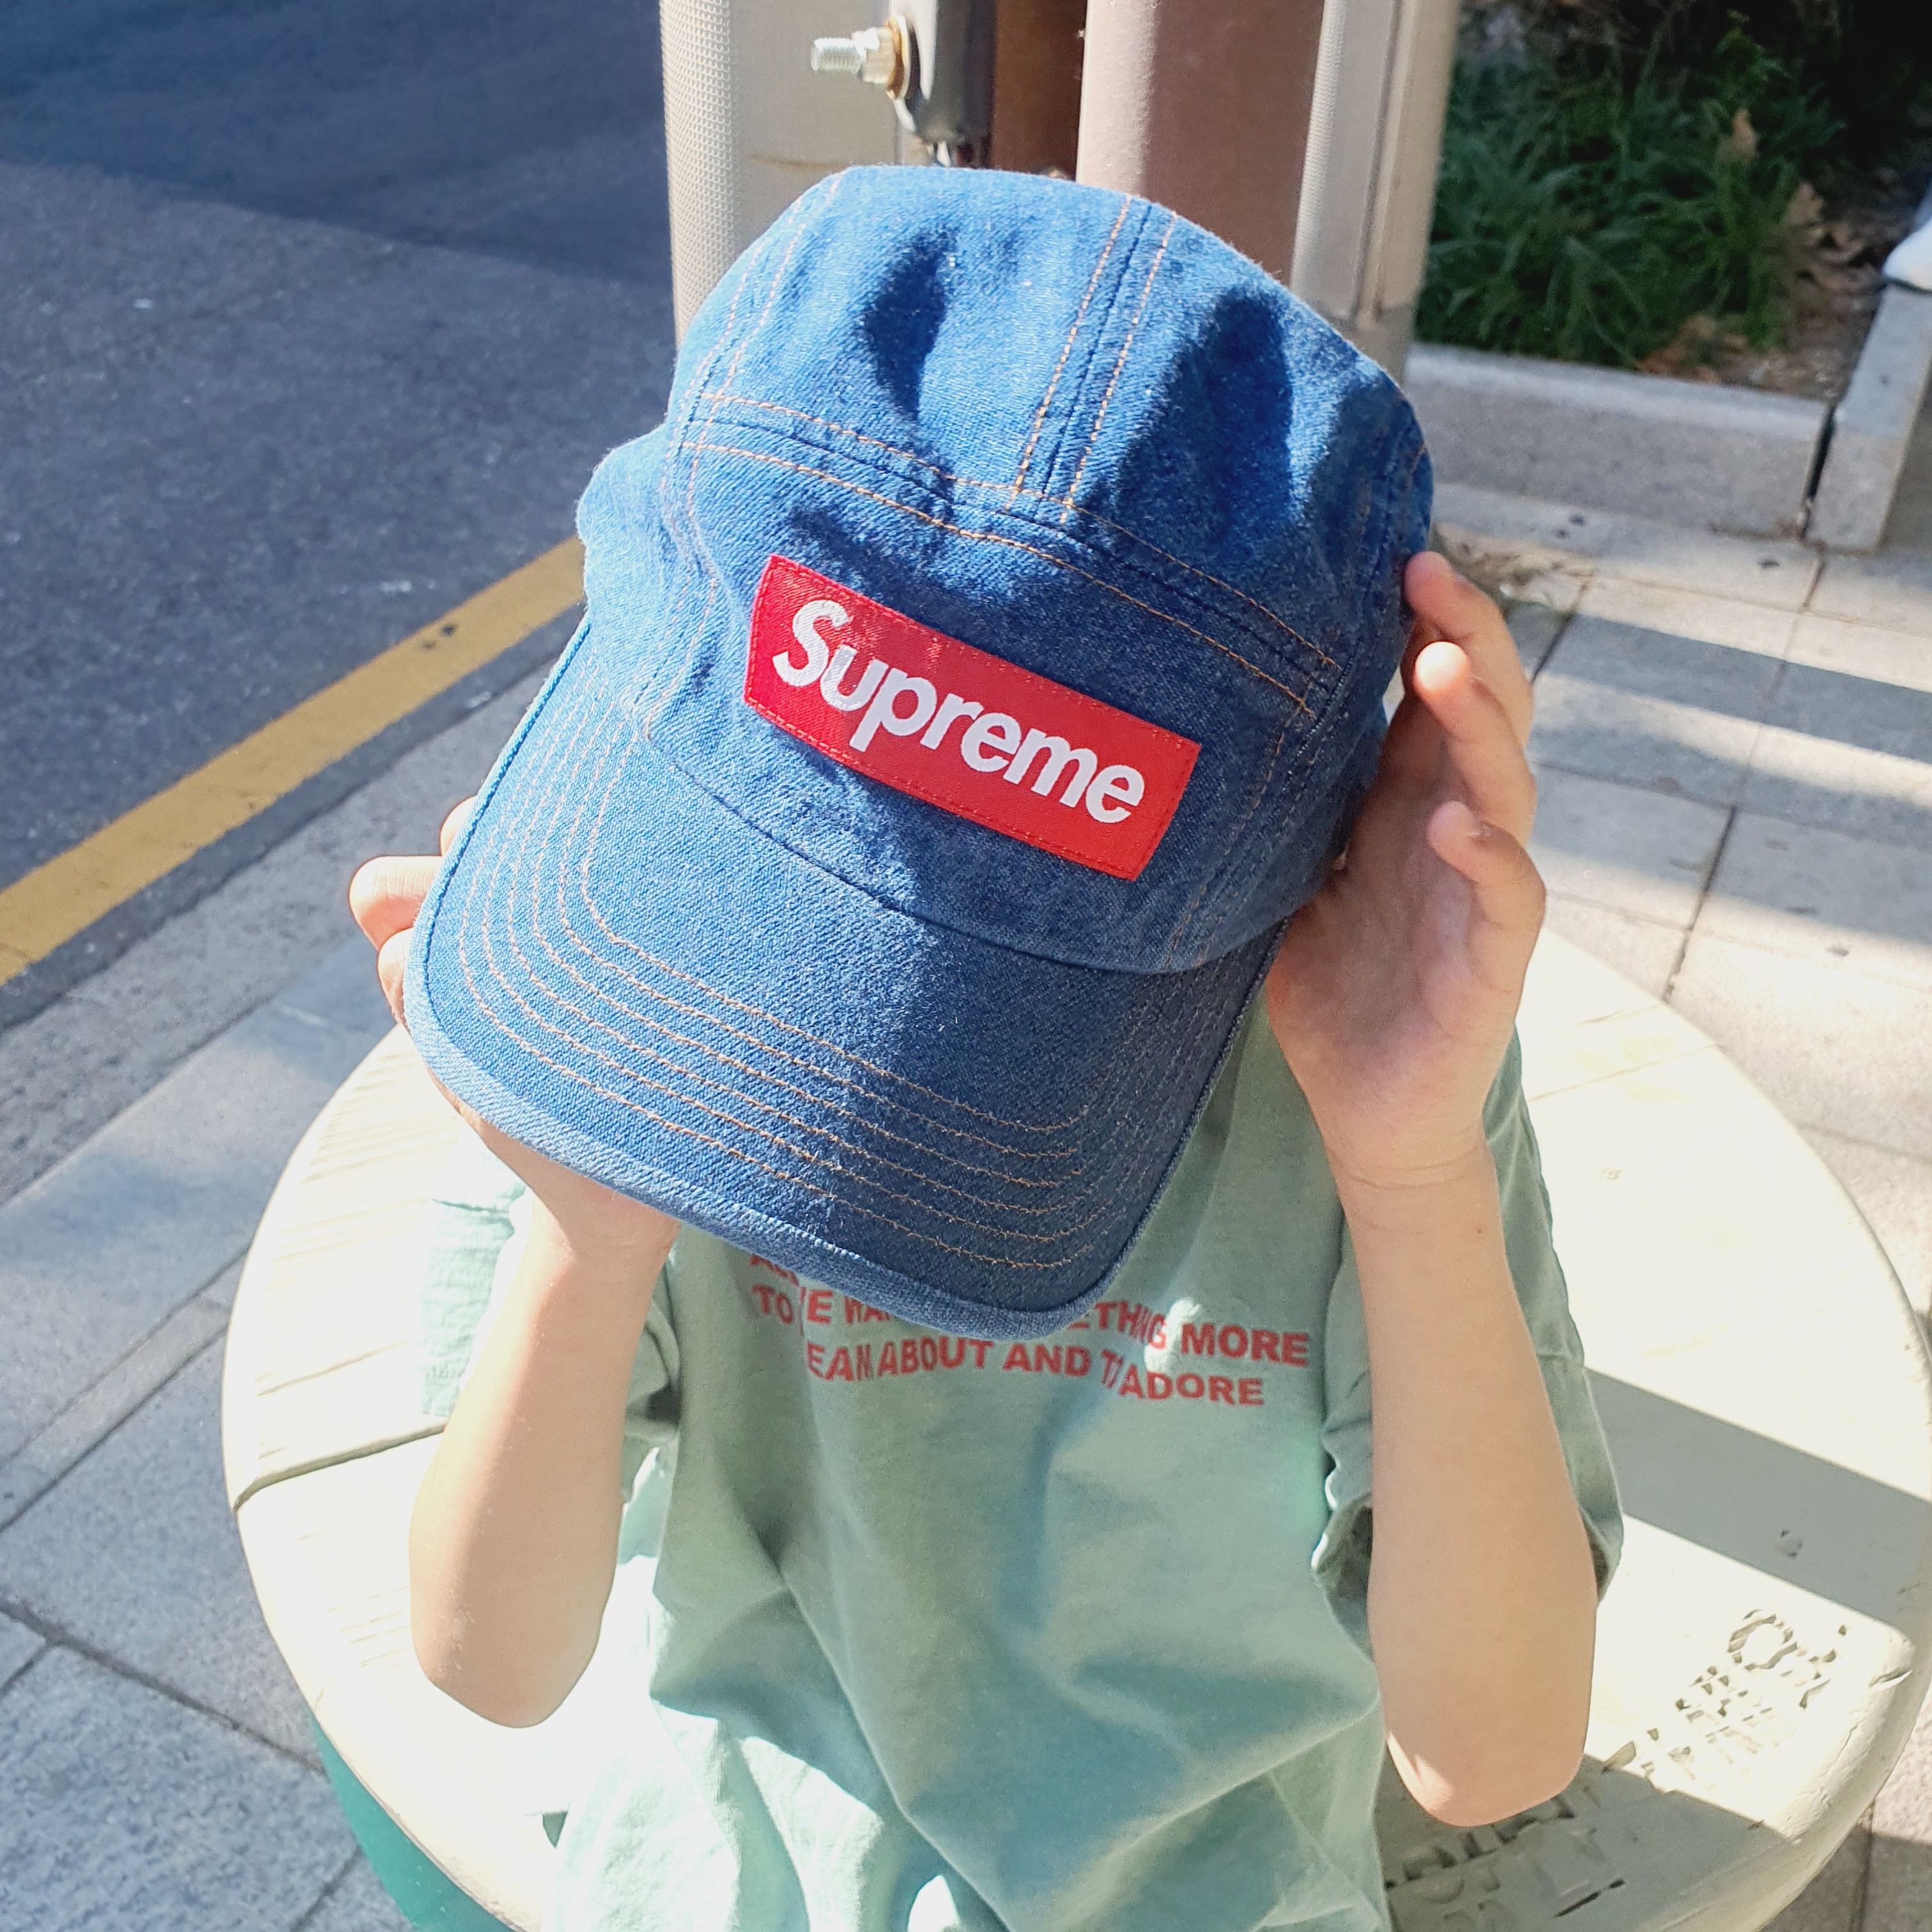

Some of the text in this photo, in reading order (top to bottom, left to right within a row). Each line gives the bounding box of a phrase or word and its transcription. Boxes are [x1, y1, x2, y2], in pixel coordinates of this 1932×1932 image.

[772, 599, 1144, 824] Supreme
[752, 1284, 793, 1324] TO
[1181, 1322, 1308, 1367] MORE
[877, 1335, 994, 1377] ABOUT
[1002, 1343, 1091, 1377] AND
[1119, 1363, 1264, 1406] ADORE
